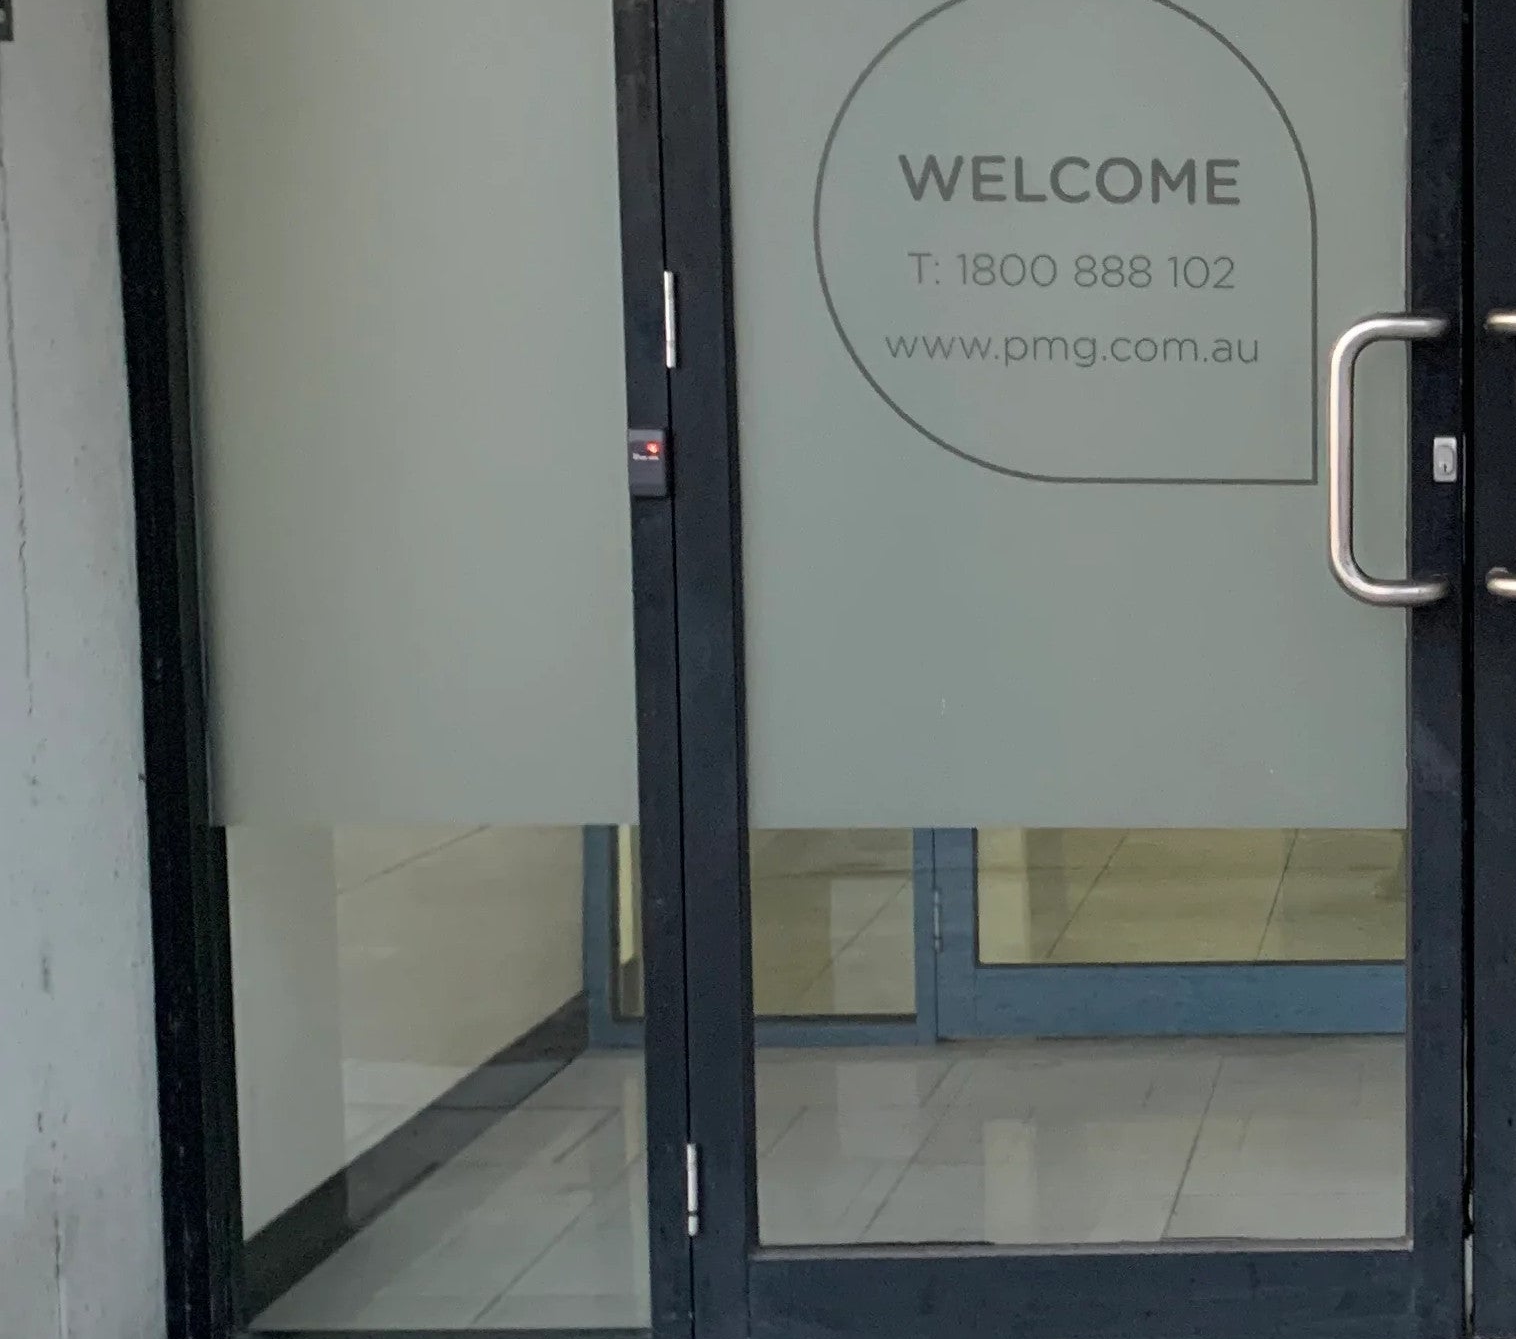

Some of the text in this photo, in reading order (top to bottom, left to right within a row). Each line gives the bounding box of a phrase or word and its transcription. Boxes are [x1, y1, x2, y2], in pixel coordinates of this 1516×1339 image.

[898, 154, 1241, 207] WELCOME
[908, 251, 1236, 290] T: 1800 888 102
[885, 334, 1260, 370] www.pmg.com.au
